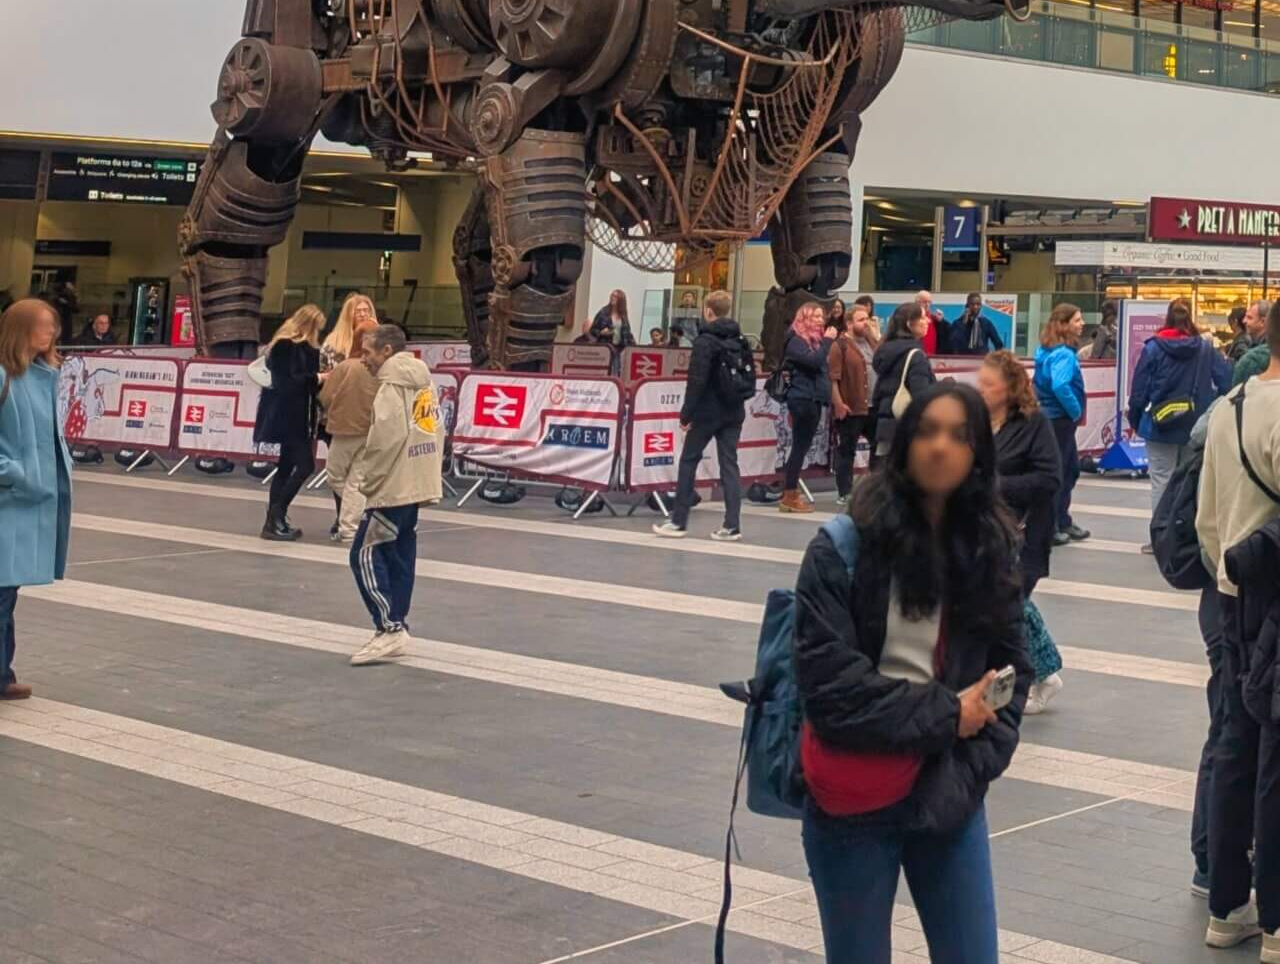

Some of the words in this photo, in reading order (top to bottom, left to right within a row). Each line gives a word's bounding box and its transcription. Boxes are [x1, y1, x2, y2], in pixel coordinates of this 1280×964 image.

[77, 156, 111, 166] Platforms
[162, 172, 184, 181] Toilets
[100, 191, 123, 200] Toilets
[1197, 205, 1225, 234] PRET
[1227, 209, 1235, 235] A
[953, 216, 965, 239] 7
[1183, 251, 1201, 262] Good
[1203, 252, 1219, 262] Food
[661, 394, 681, 405] OZZY
